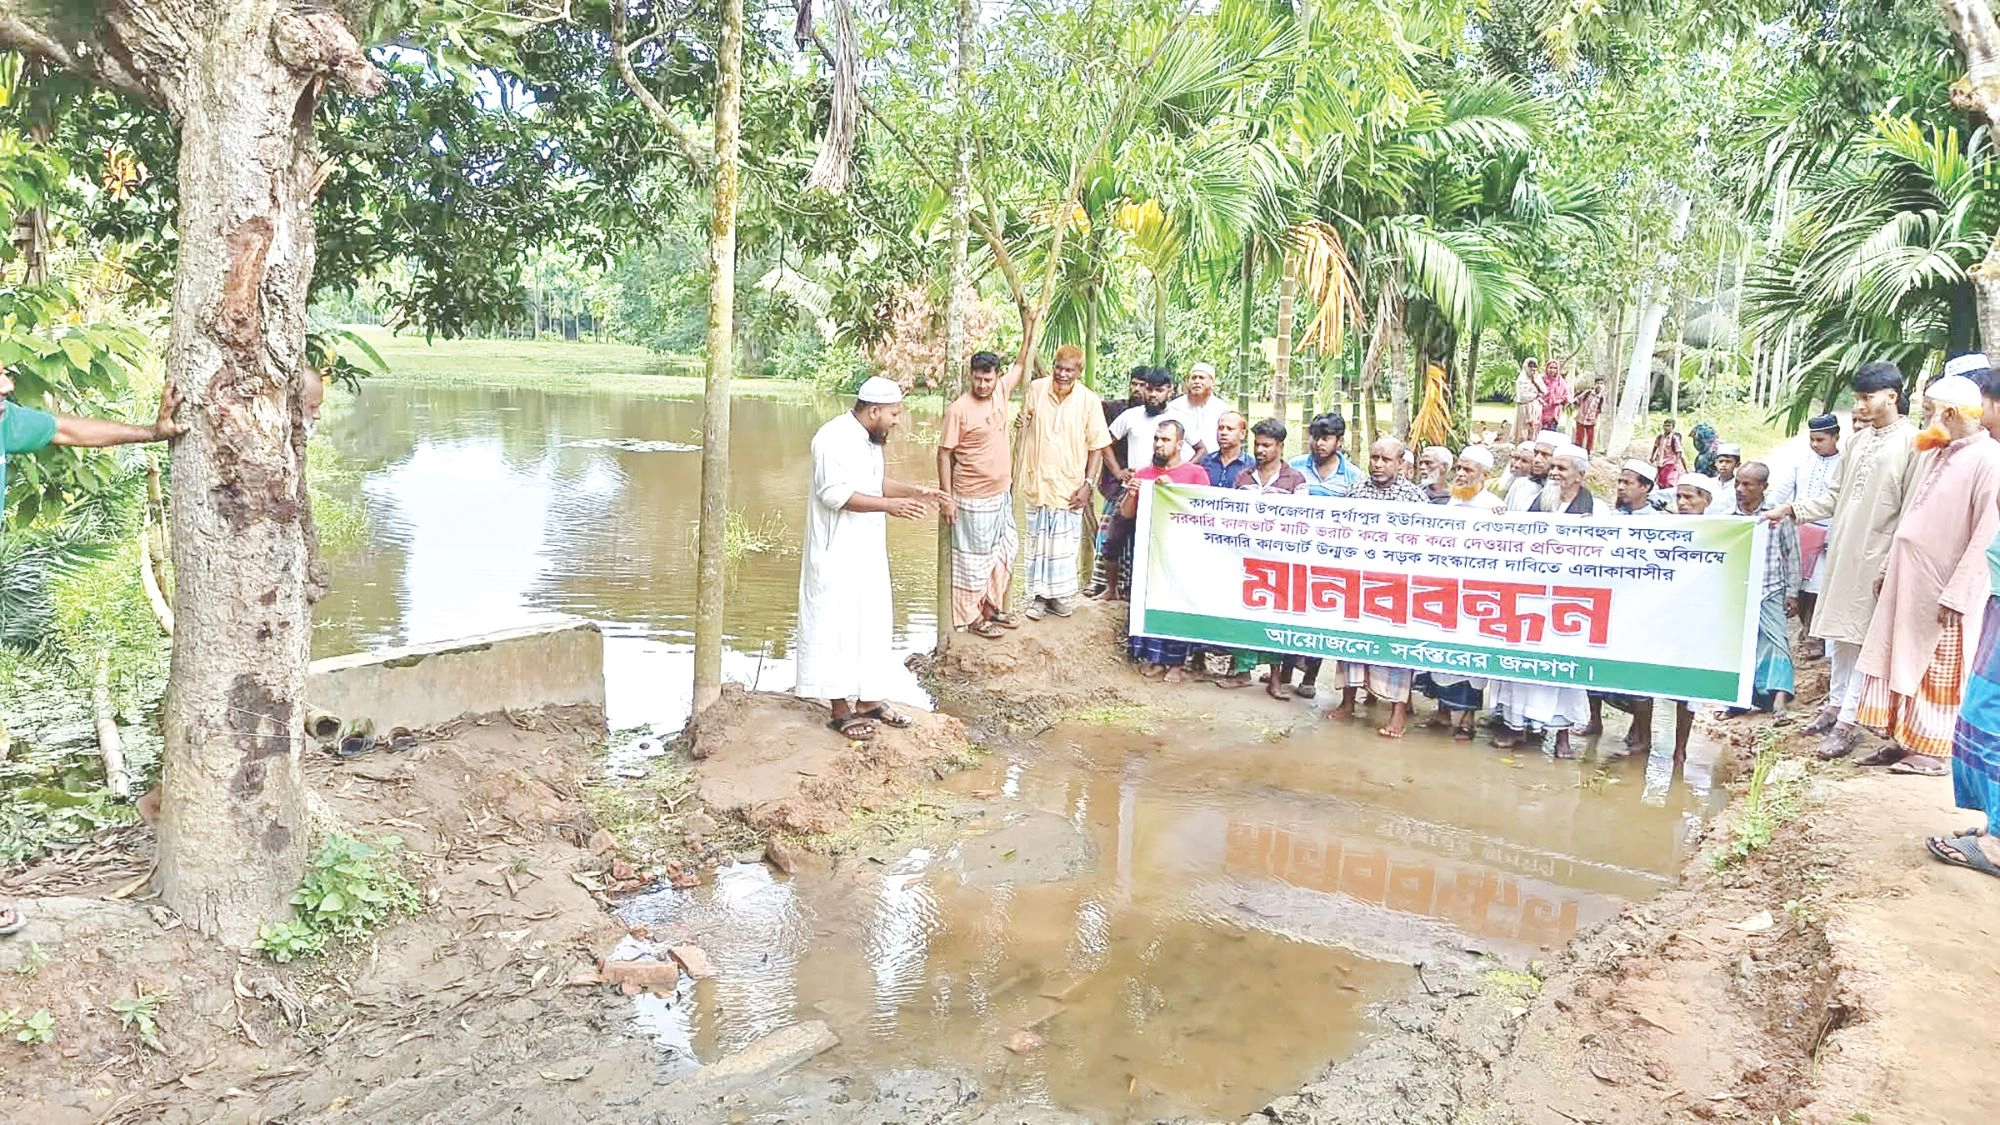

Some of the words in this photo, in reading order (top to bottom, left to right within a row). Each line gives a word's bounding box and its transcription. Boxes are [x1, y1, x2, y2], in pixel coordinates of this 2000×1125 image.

[1170, 511, 1216, 528] সরকারি
[1221, 517, 1275, 532] কালভার্ট
[1280, 521, 1311, 535] মাটি
[1316, 526, 1354, 539] ভরাট
[1358, 529, 1389, 543] করে
[1395, 532, 1419, 547] বন্ধ
[1426, 535, 1458, 548] করে
[1464, 537, 1525, 553] দেওয়ার
[1530, 539, 1604, 557] প্রতিবাদে
[1610, 546, 1649, 561] এবং
[1654, 546, 1727, 564] অবিলম্বে
[1189, 497, 1251, 514] কাপাসিয়া
[1255, 500, 1325, 520] উপজেলার
[1331, 508, 1381, 525] দুর্গাপুর
[1386, 511, 1466, 531] ইউনিয়নের
[1473, 521, 1549, 535] বেগুনহাটি
[1556, 524, 1622, 541] জনবহুল
[1628, 527, 1694, 543] সড়কের
[1203, 531, 1251, 549] সরকারি
[1256, 538, 1312, 553] কালভার্ট
[1316, 542, 1359, 560] উন্মুক্ত
[1364, 548, 1376, 559] ও
[1383, 550, 1422, 565] সড়ক
[1428, 553, 1499, 570] সংস্কারের
[1505, 557, 1562, 573] দাবিতে
[1568, 563, 1676, 582] এলাকাবাসীর
[1242, 557, 1614, 645] মানববন্ধন
[1264, 627, 1381, 654] আয়োজনে:
[1388, 641, 1492, 669] সর্বস্তরের
[1499, 653, 1579, 680] জনগণ
